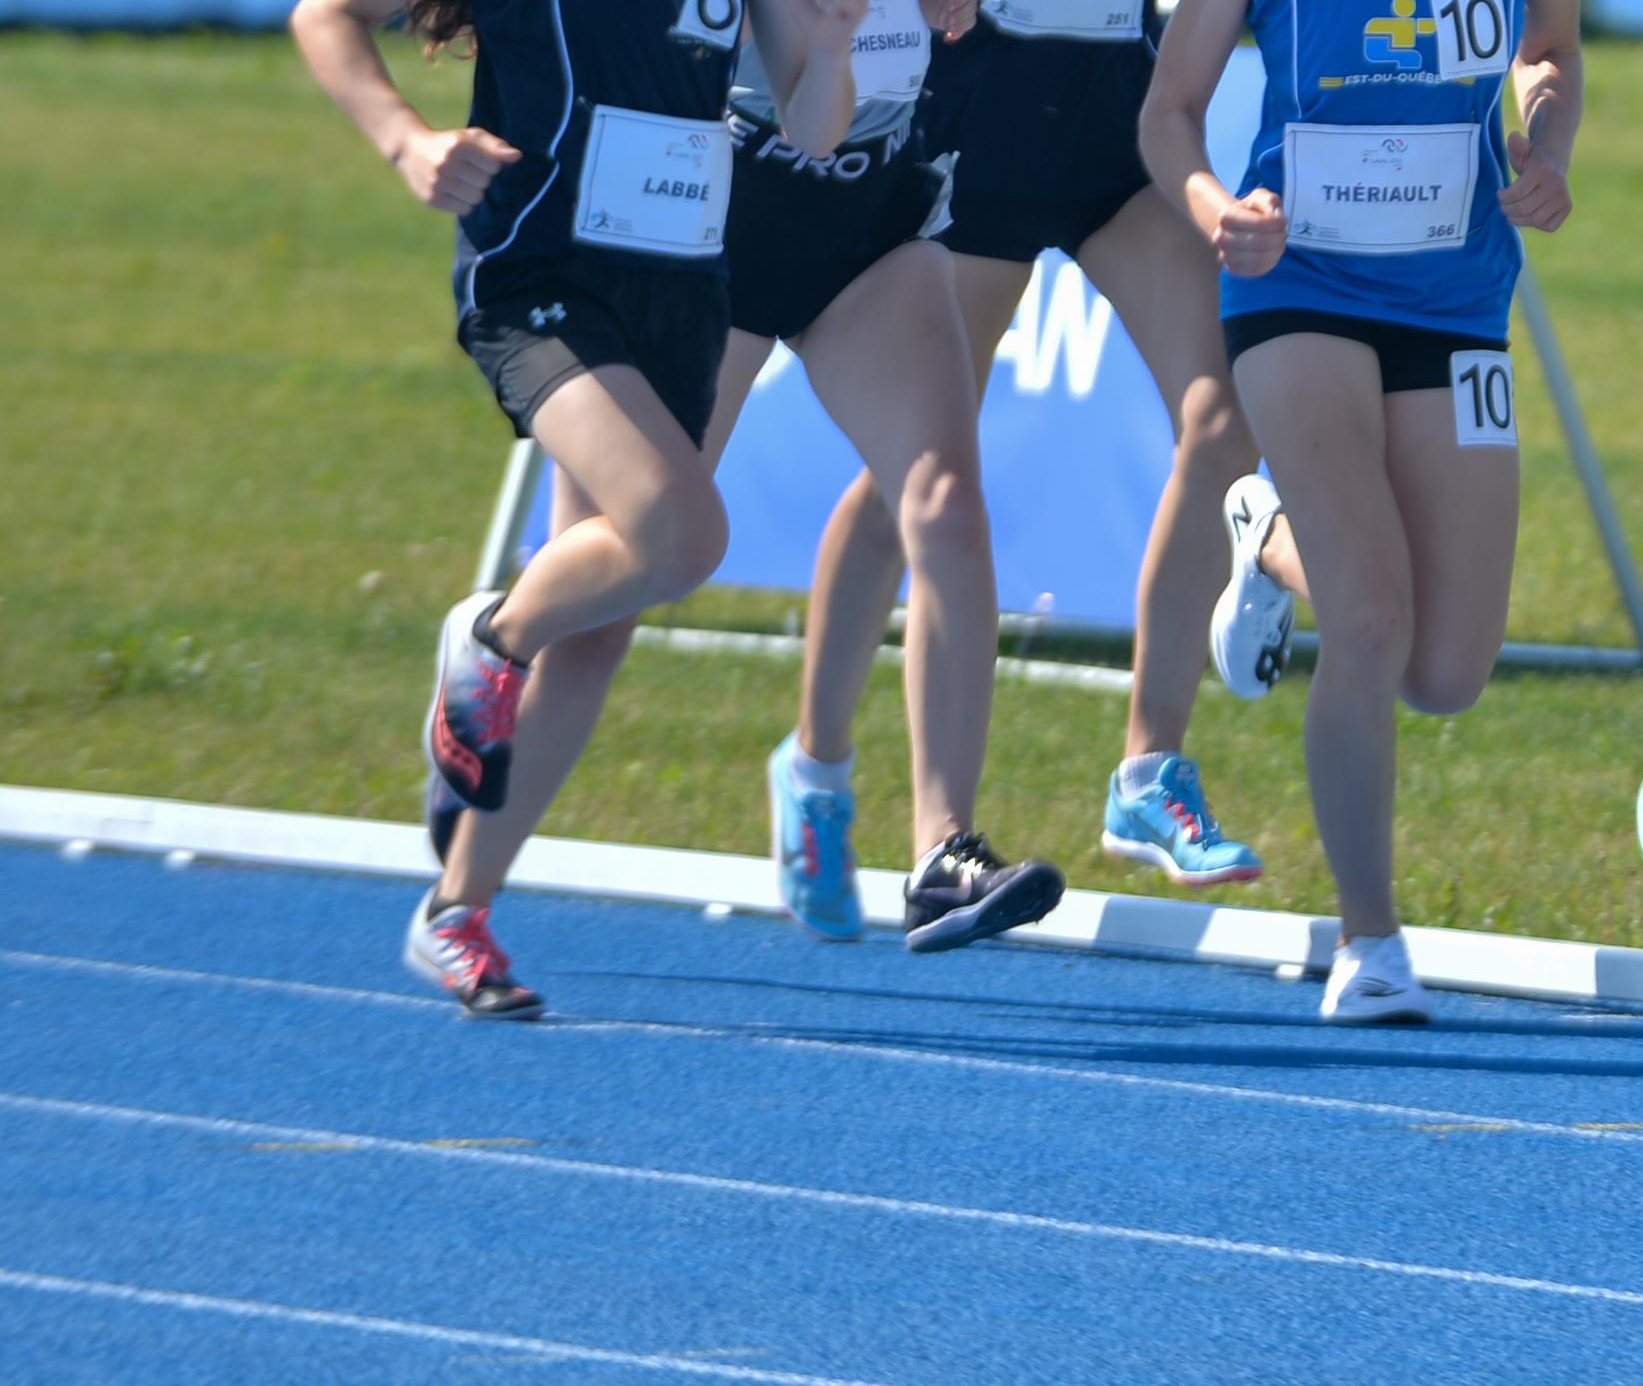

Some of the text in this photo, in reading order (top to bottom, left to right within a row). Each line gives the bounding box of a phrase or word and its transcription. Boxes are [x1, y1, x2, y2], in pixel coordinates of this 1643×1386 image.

[643, 177, 711, 202] LABBÉ
[1322, 183, 1442, 203] THÉRIAULT
[1428, 224, 1455, 238] 366
[1460, 363, 1511, 429] 10
